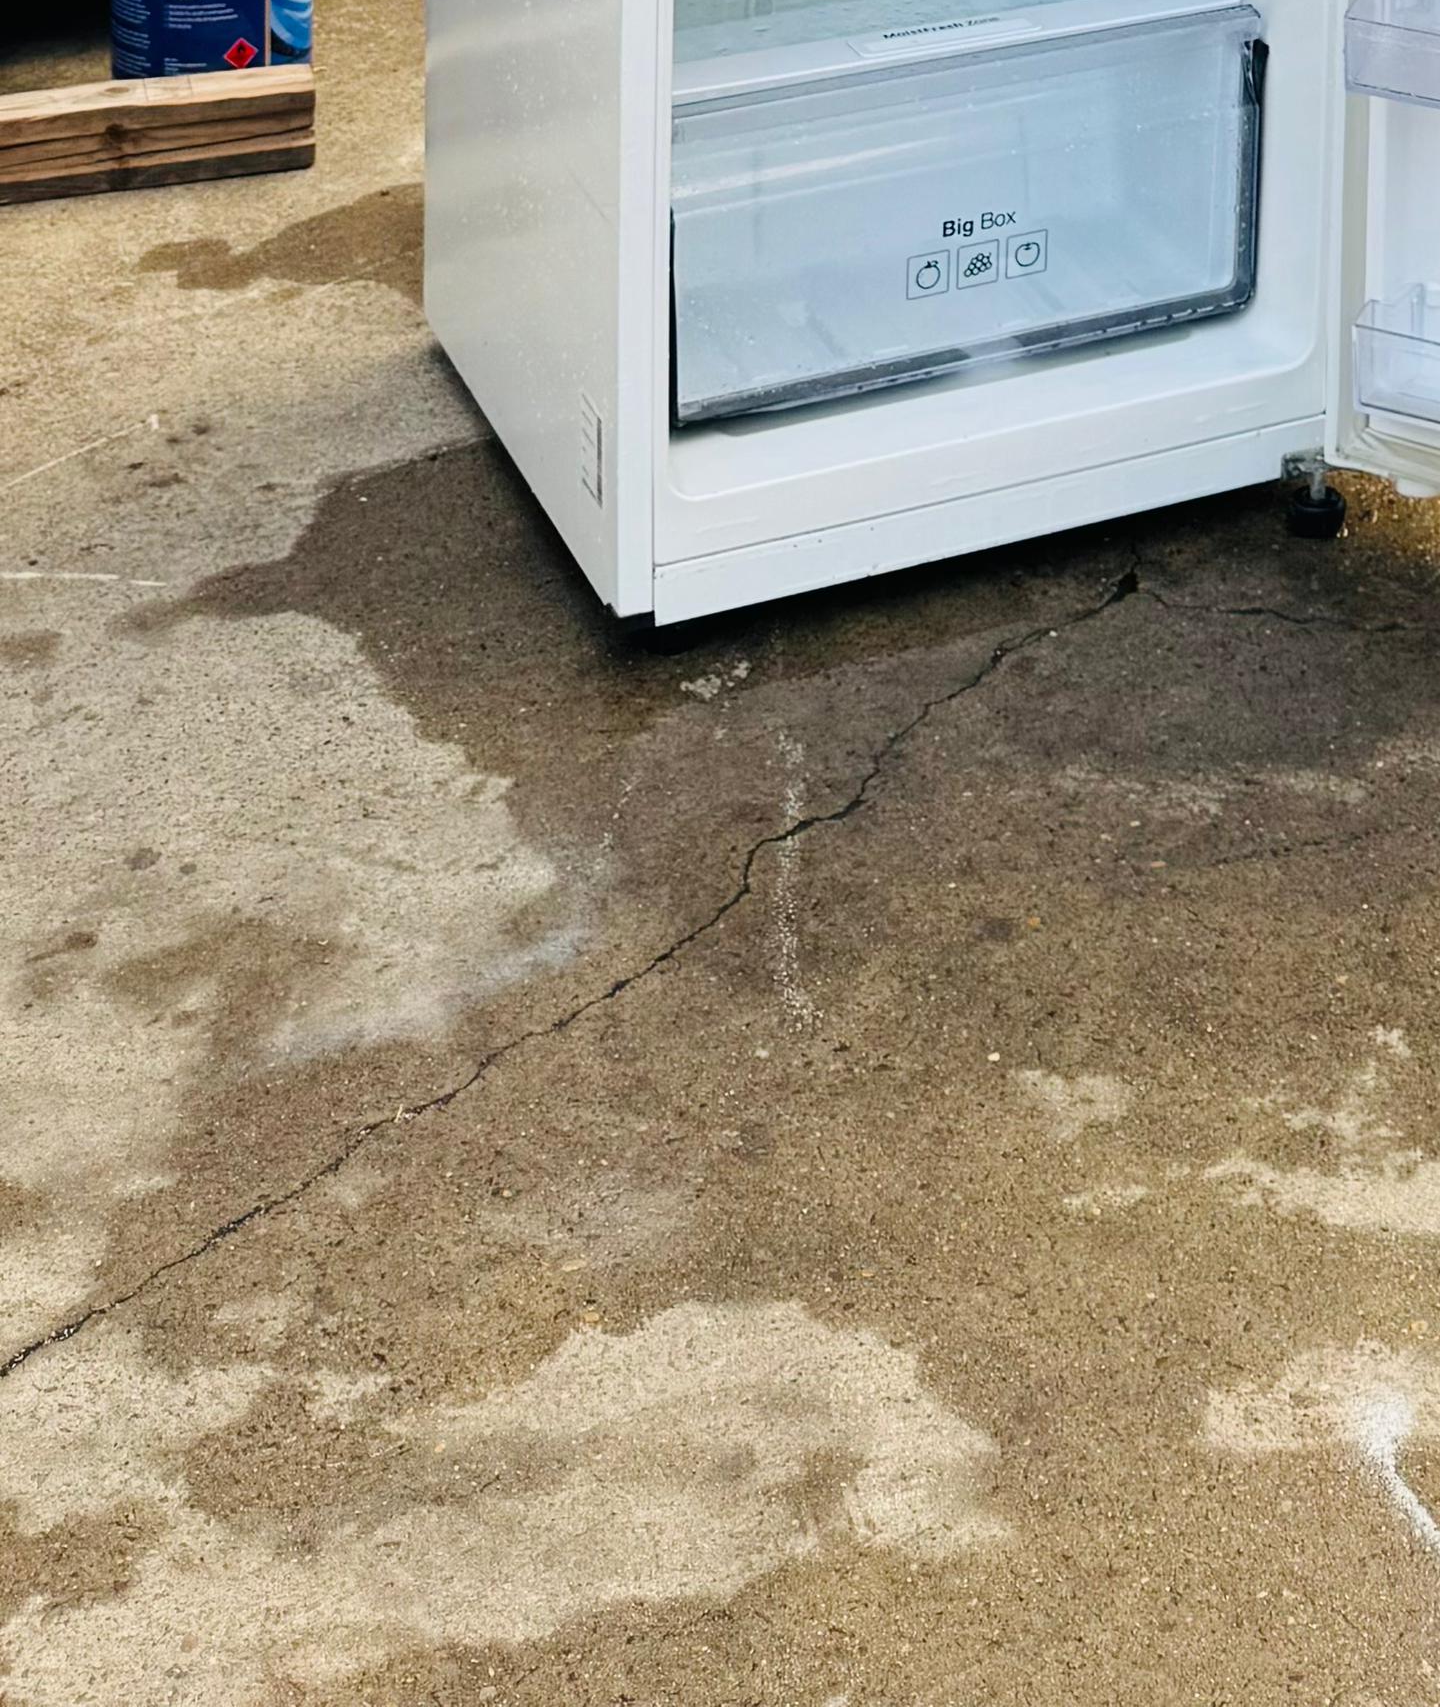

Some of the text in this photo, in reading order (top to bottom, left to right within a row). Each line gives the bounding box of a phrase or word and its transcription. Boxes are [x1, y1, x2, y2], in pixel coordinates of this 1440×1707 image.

[883, 23, 963, 38] MoistFresh
[942, 211, 1016, 237] Big Box
